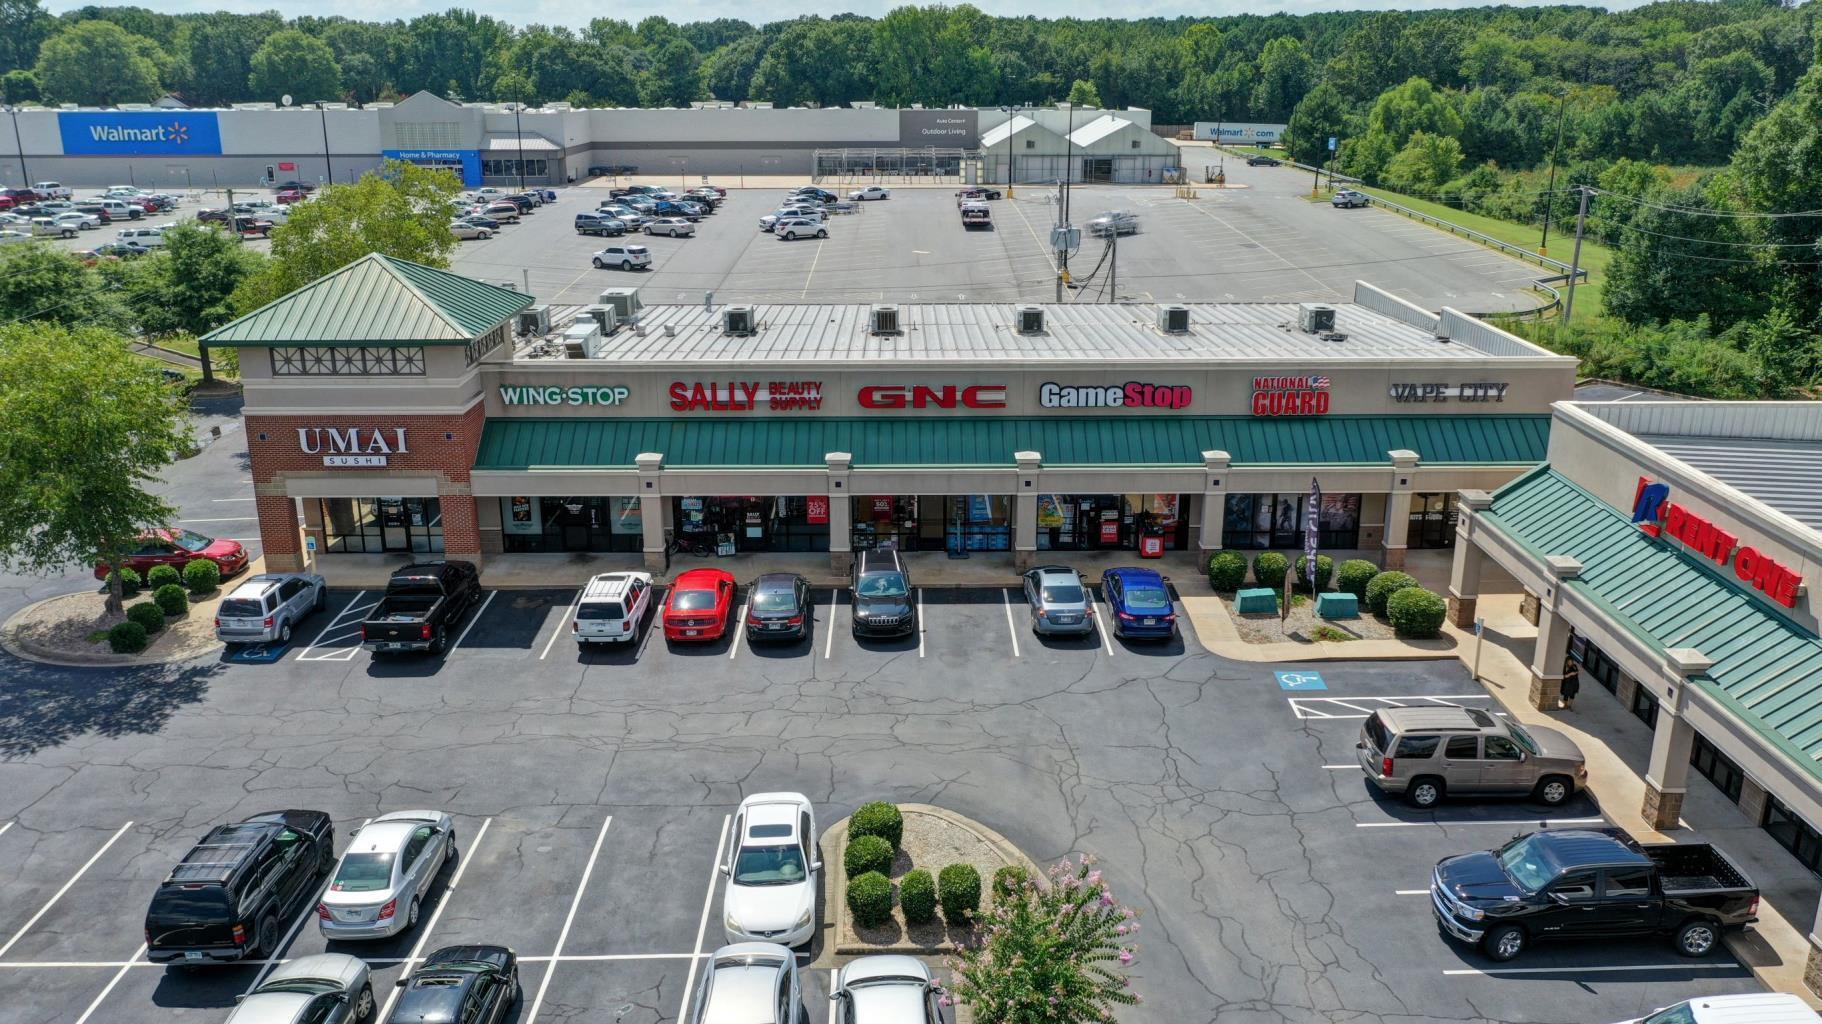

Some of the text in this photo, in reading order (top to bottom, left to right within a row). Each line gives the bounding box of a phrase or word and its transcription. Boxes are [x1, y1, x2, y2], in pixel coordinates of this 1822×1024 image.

[89, 125, 166, 142] Walmart
[948, 128, 966, 136] Living
[1210, 127, 1243, 136] Walmart
[399, 151, 461, 160] Home & Pharmacy
[768, 381, 823, 396] BEAUTY
[1253, 376, 1311, 391] NATIONAL
[669, 381, 760, 412] SALLY
[857, 385, 1007, 409] GNC
[1040, 381, 1192, 410] GameStop
[1391, 382, 1510, 403] VAPE CITY
[769, 396, 824, 411] SUPPLY
[1252, 390, 1330, 416] GUARD
[296, 427, 409, 454] UMAI
[329, 457, 382, 465] SUSHI
[1664, 501, 1803, 609] RENT ONE
